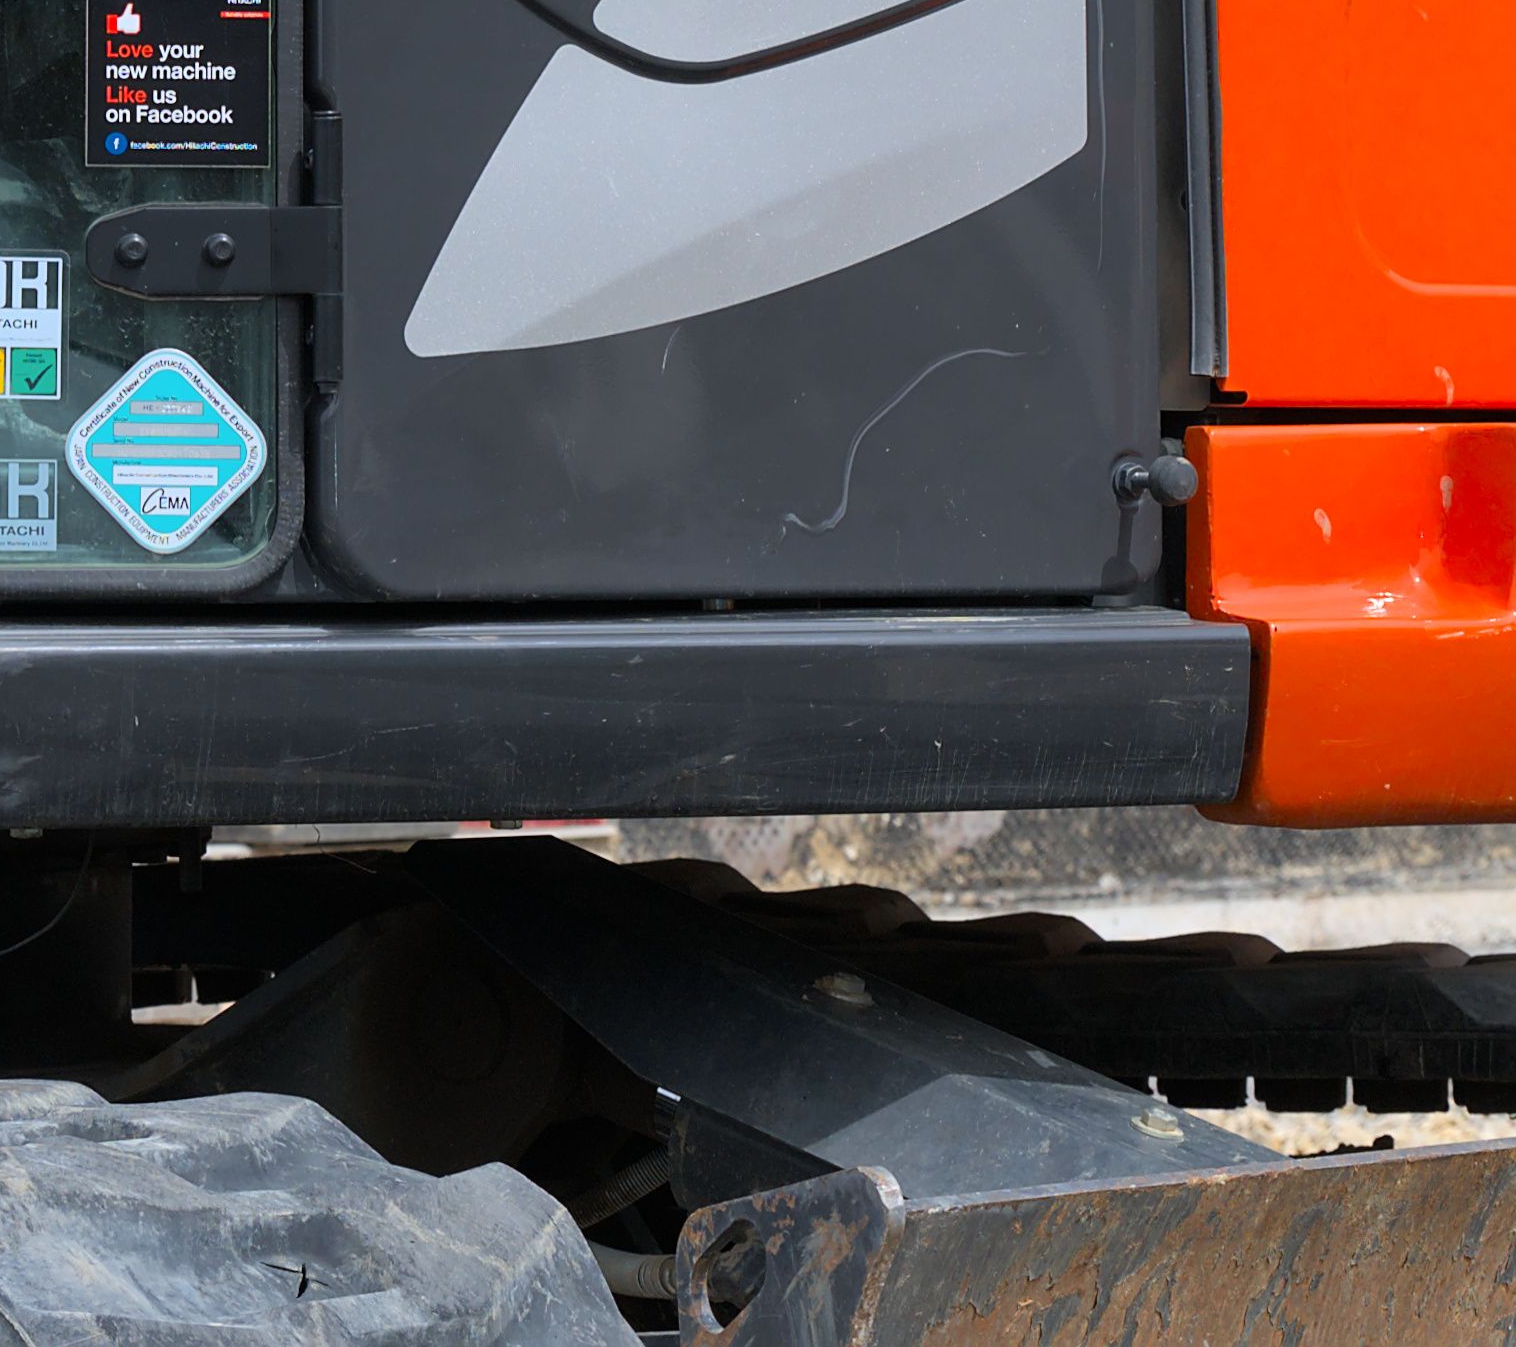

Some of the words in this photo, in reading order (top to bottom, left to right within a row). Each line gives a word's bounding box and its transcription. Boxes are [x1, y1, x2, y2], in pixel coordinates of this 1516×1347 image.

[106, 40, 154, 58] Love
[158, 43, 205, 62] your
[105, 63, 148, 80] new
[152, 61, 236, 81] machine
[106, 86, 147, 104] Like
[153, 89, 177, 104] us
[105, 108, 131, 124] on
[136, 105, 234, 124] Facebook
[130, 140, 258, 151] facebook.com/HitachiConstruction
[79, 401, 117, 438] Certificate
[123, 378, 139, 395] New
[138, 360, 193, 380] Construction
[192, 375, 220, 406] Machine
[219, 404, 230, 416] for
[229, 414, 254, 441] Export
[73, 444, 87, 470] JAPAN
[85, 469, 129, 517] CONSTRUCTION
[128, 515, 170, 545] EQUIPMENT
[176, 488, 228, 541] MANUFACTURERS
[228, 445, 259, 492] ASSOCIATION
[142, 488, 189, 514] CEMA
